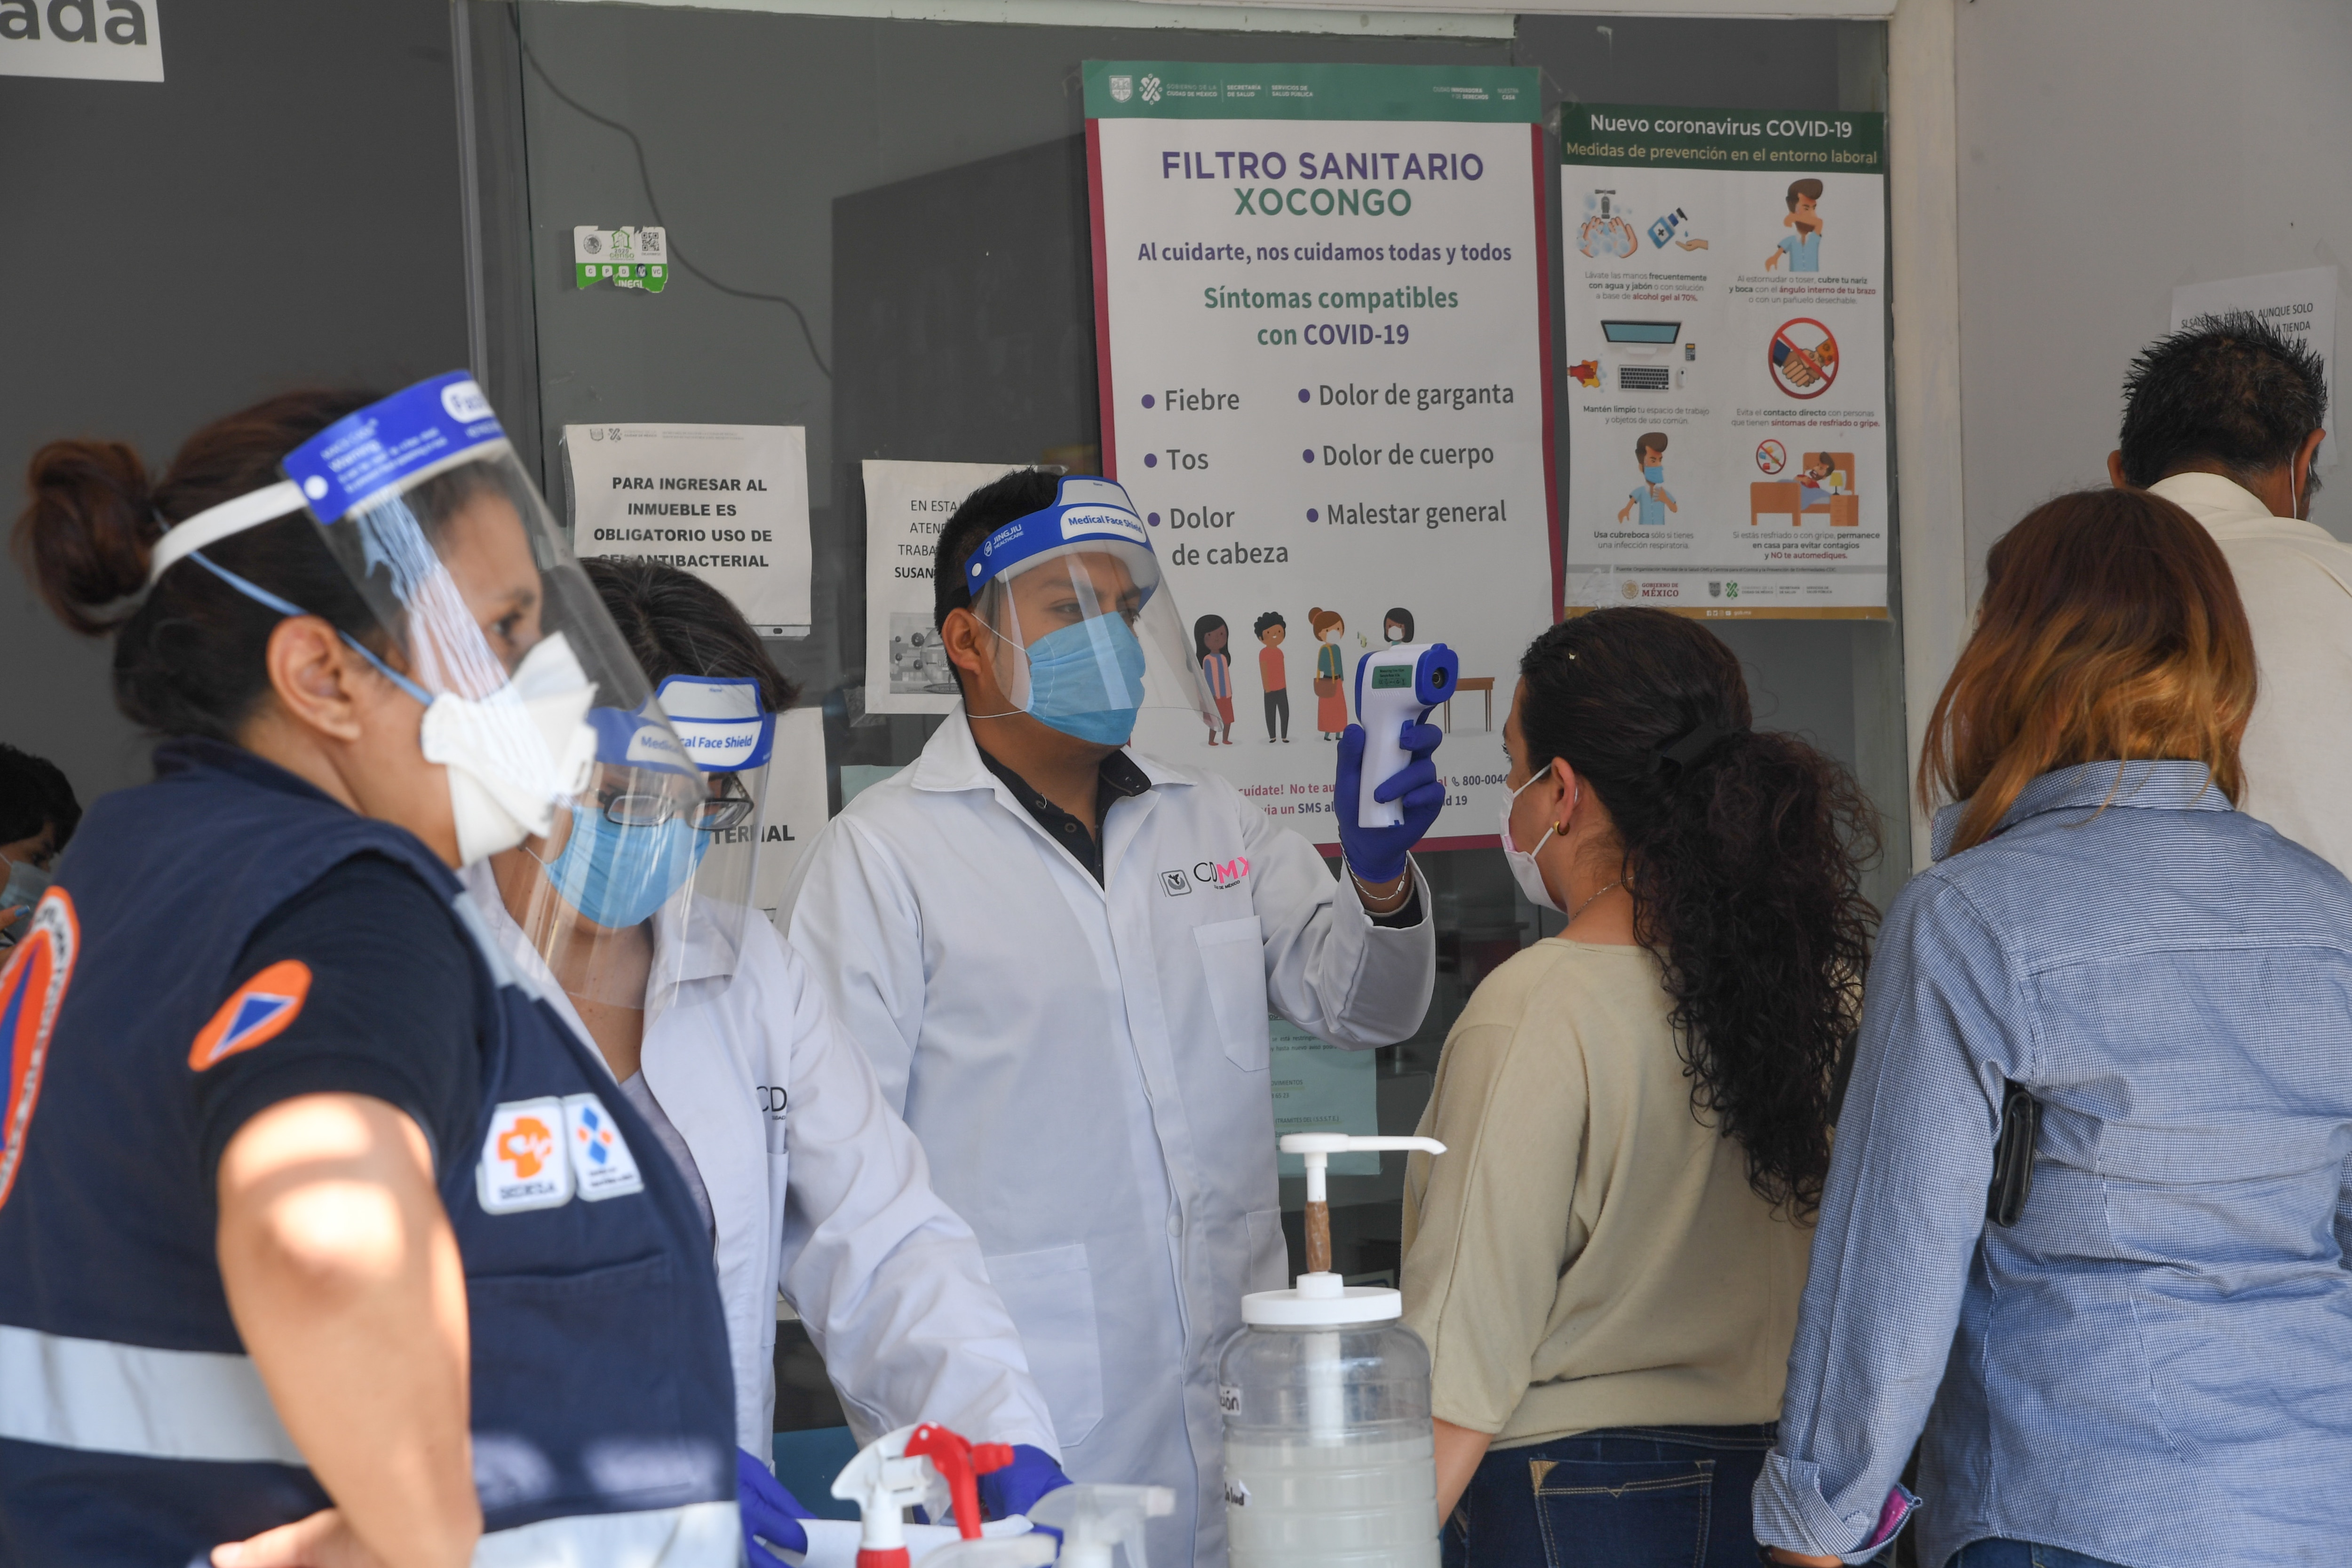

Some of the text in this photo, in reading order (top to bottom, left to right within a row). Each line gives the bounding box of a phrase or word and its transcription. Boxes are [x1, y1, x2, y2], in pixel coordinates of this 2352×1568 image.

[1591, 114, 1852, 138] Nuevo coronavirus COVID-19
[1567, 142, 1877, 164] Medidas de prevención en el entorno laboral
[1162, 151, 1483, 181] FILTRO SANITARIO
[1234, 188, 1411, 216] XOCONGO
[1138, 242, 1511, 265] Al cuidarte, nos cuidamos todas y todos
[1649, 272, 1707, 281] frecuentemente
[1660, 294, 1672, 302] gel
[1780, 286, 1805, 294] ángulo
[1204, 286, 1458, 313] Síntomas compatibles
[2258, 306, 2290, 318] AUNQUE
[2292, 303, 2313, 314] SOLO
[1258, 324, 1409, 345] con COVID-19
[2282, 321, 2310, 332] TIENDA
[1166, 388, 1239, 411] Fiebre
[1320, 383, 1513, 411] Dolor de garganta
[1614, 406, 1636, 414] limpio
[1859, 420, 1880, 428] gripe.
[1166, 449, 1208, 470] Tos
[1323, 443, 1494, 469] Dolor de cuerpo
[613, 477, 767, 491] PARA INGRESAR AL
[628, 503, 736, 516] INMUEBLE ES
[911, 500, 926, 511] EN
[1328, 500, 1506, 529] Malestar general
[1068, 515, 1143, 533] Medical Face Shield
[1170, 506, 1235, 529] Dolor
[594, 528, 772, 541] OBLIGATORIO USO DE
[993, 524, 1022, 545] JINGJIU
[994, 531, 1024, 549] HEALTHCARE
[1172, 542, 1288, 565] de cabeza
[1823, 542, 1859, 550] contagios
[699, 737, 722, 748] Face
[725, 735, 753, 748] Shield
[1290, 784, 1305, 794] No
[1308, 784, 1319, 794] te
[1298, 804, 1321, 813] SMS
[1455, 796, 1468, 806] 19
